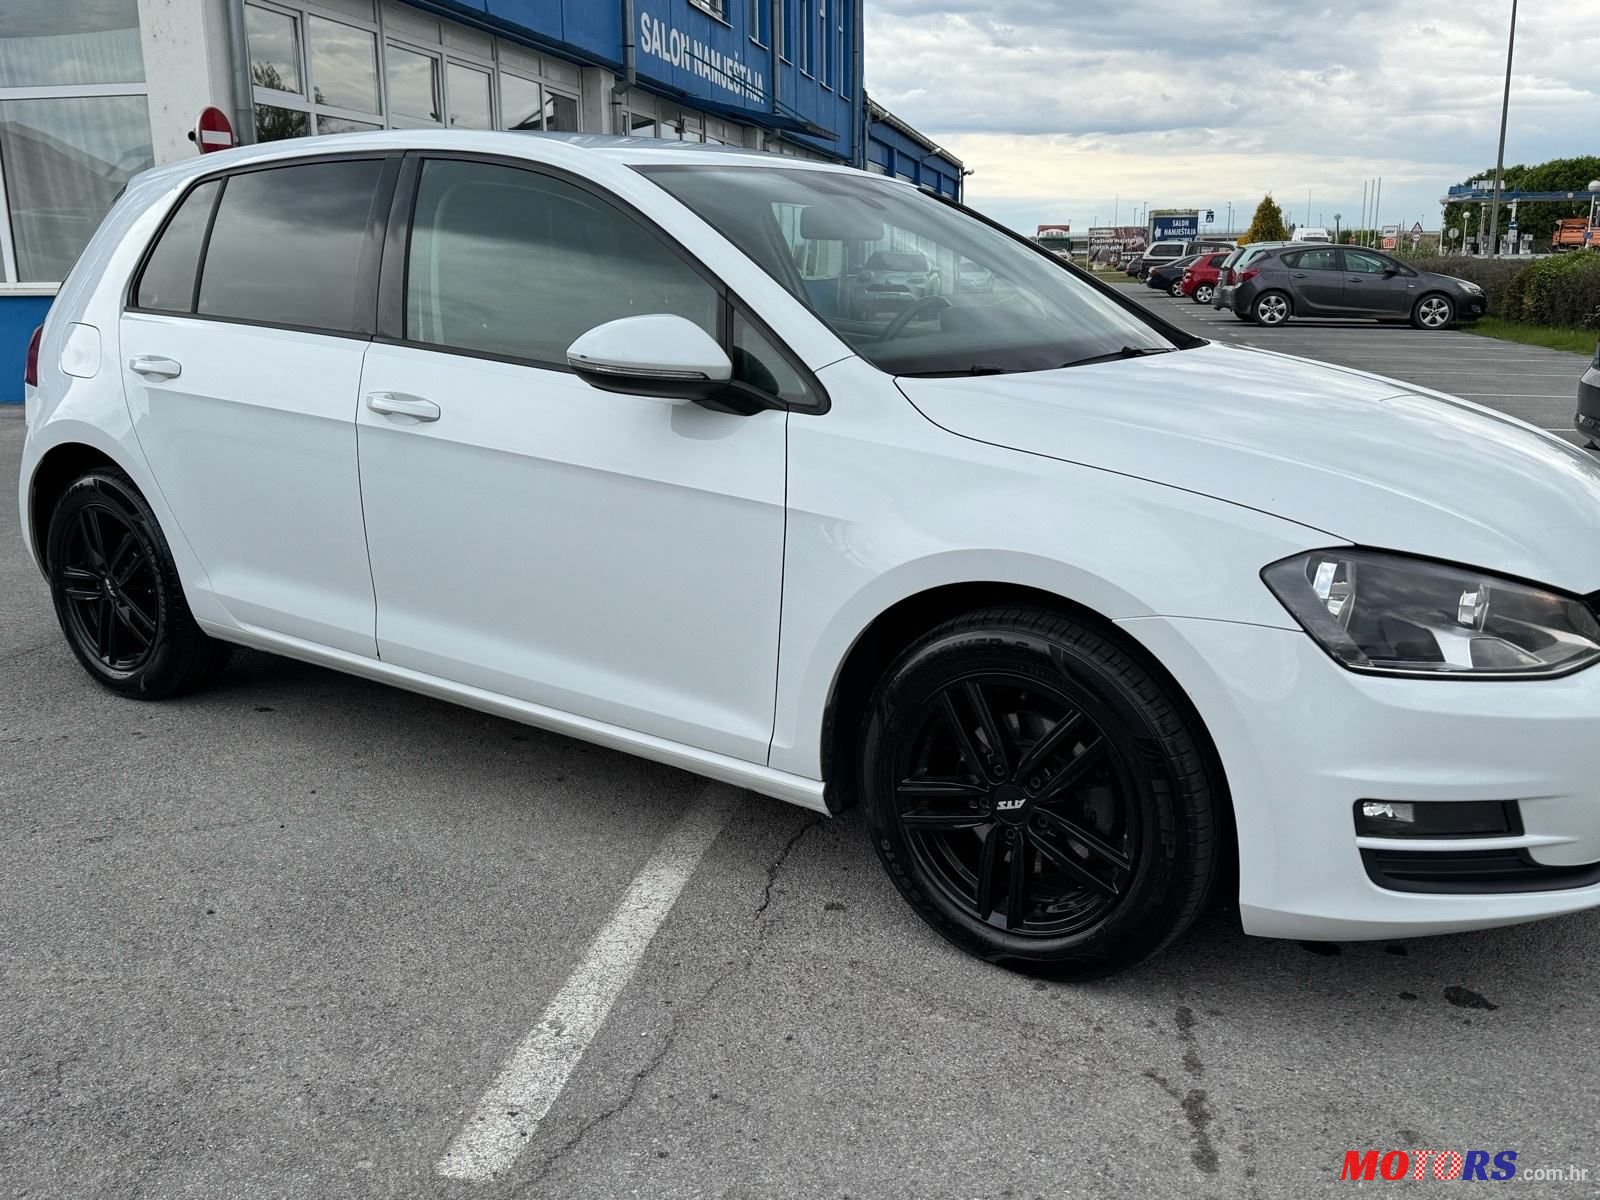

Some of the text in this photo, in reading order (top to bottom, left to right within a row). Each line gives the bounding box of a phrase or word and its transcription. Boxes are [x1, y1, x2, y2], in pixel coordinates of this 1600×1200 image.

[641, 12, 764, 104] SALON NAMJEŠTAJA
[1172, 219, 1190, 227] SALON
[1164, 227, 1196, 236] NAMJEŠTAJA
